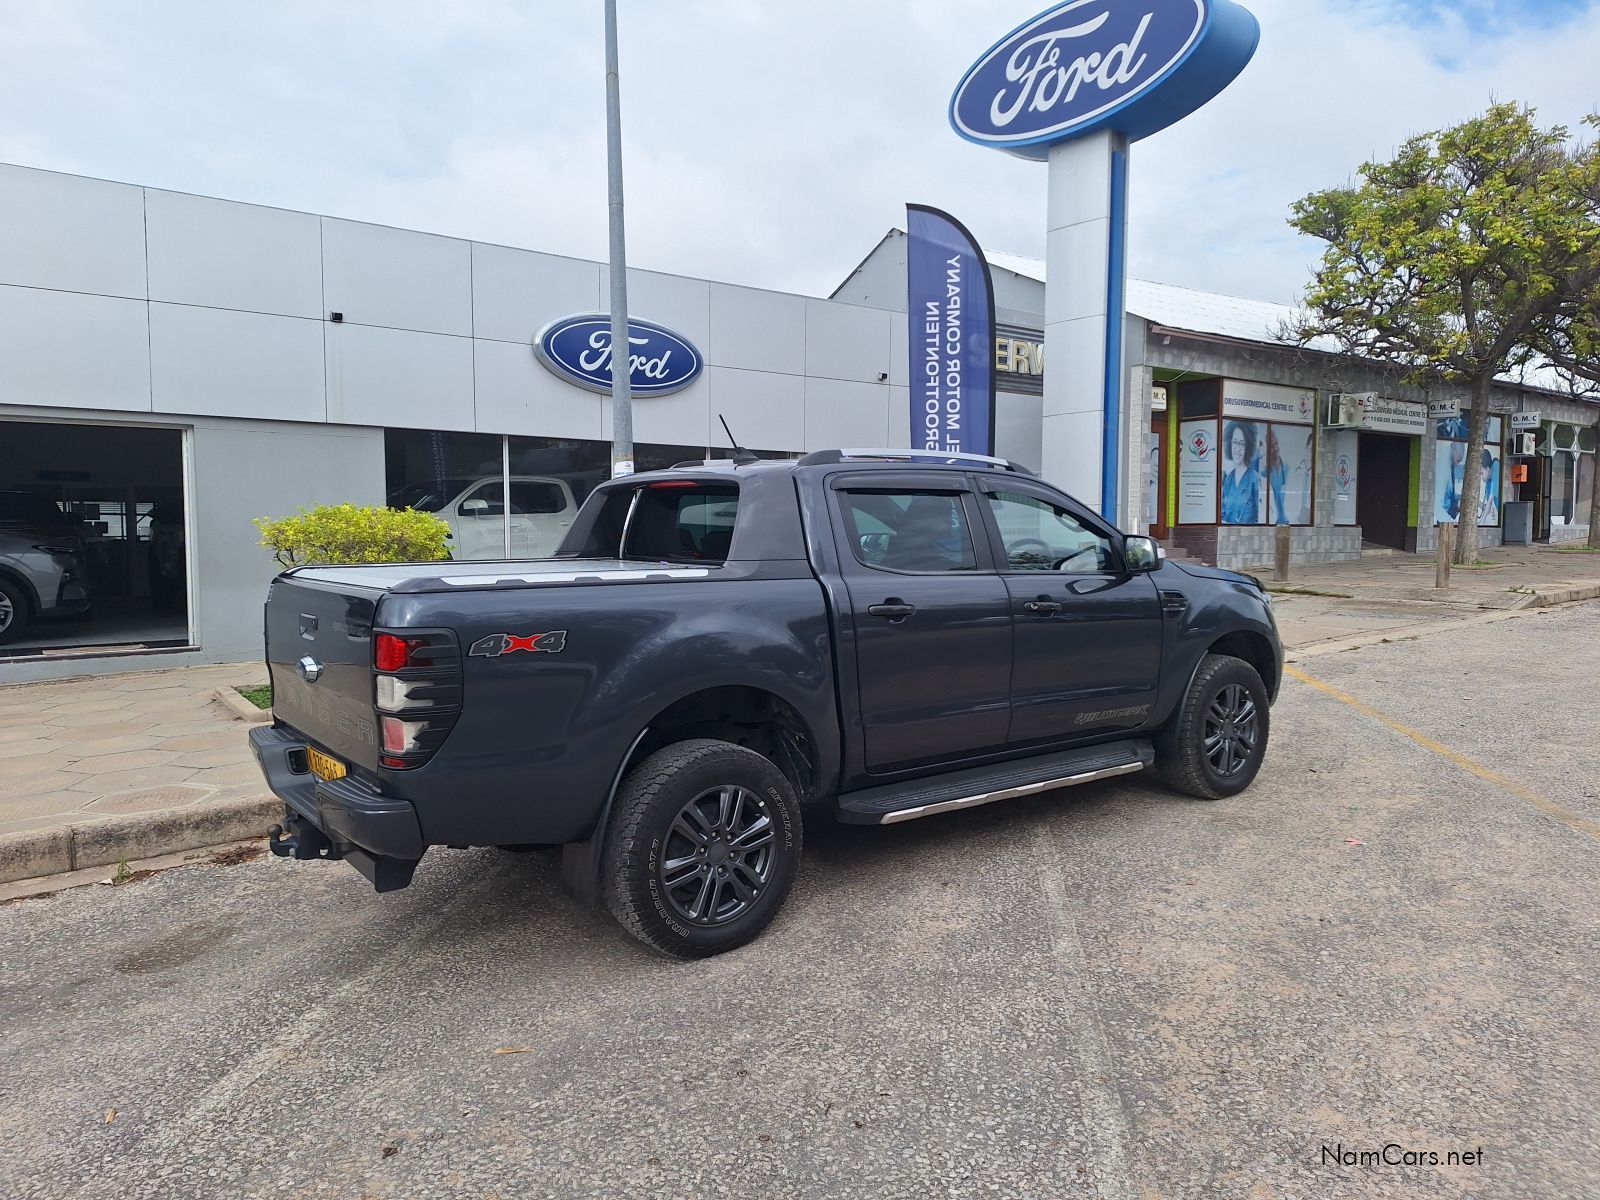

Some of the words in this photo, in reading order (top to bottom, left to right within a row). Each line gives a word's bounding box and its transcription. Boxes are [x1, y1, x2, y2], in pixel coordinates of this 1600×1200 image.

[990, 11, 1153, 126] Ford
[579, 330, 672, 379] Frd
[766, 786, 793, 847] GENERAL
[648, 879, 690, 938] GRABBER
